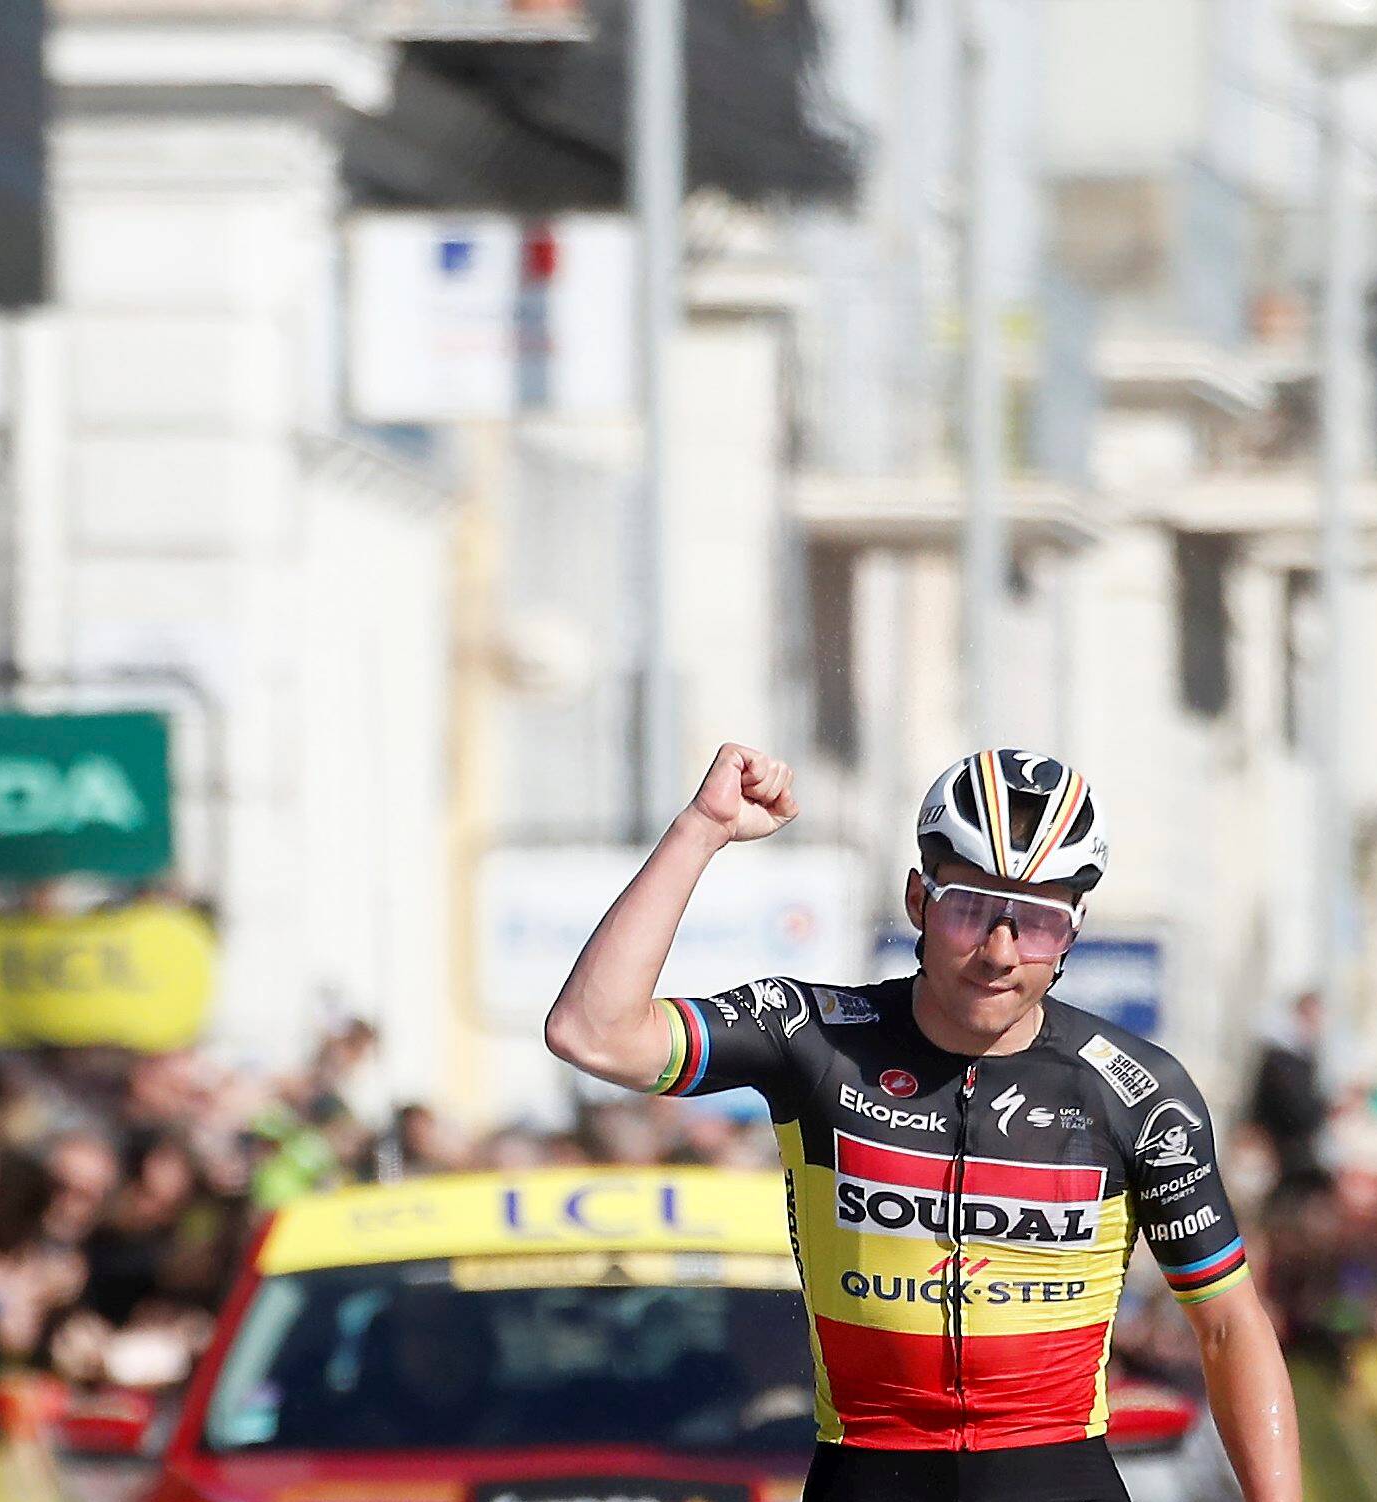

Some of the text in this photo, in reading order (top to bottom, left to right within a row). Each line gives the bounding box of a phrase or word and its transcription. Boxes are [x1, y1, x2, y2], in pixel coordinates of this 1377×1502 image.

[1106, 1061, 1144, 1100] JOGGER
[1114, 1053, 1155, 1089] SAFETY
[839, 1083, 948, 1133] Ekopak
[1059, 1108, 1081, 1116] UCI
[1140, 1162, 1212, 1201] NAPOLEON
[503, 1183, 723, 1240] LCL
[837, 1182, 1093, 1243] SOUDAL
